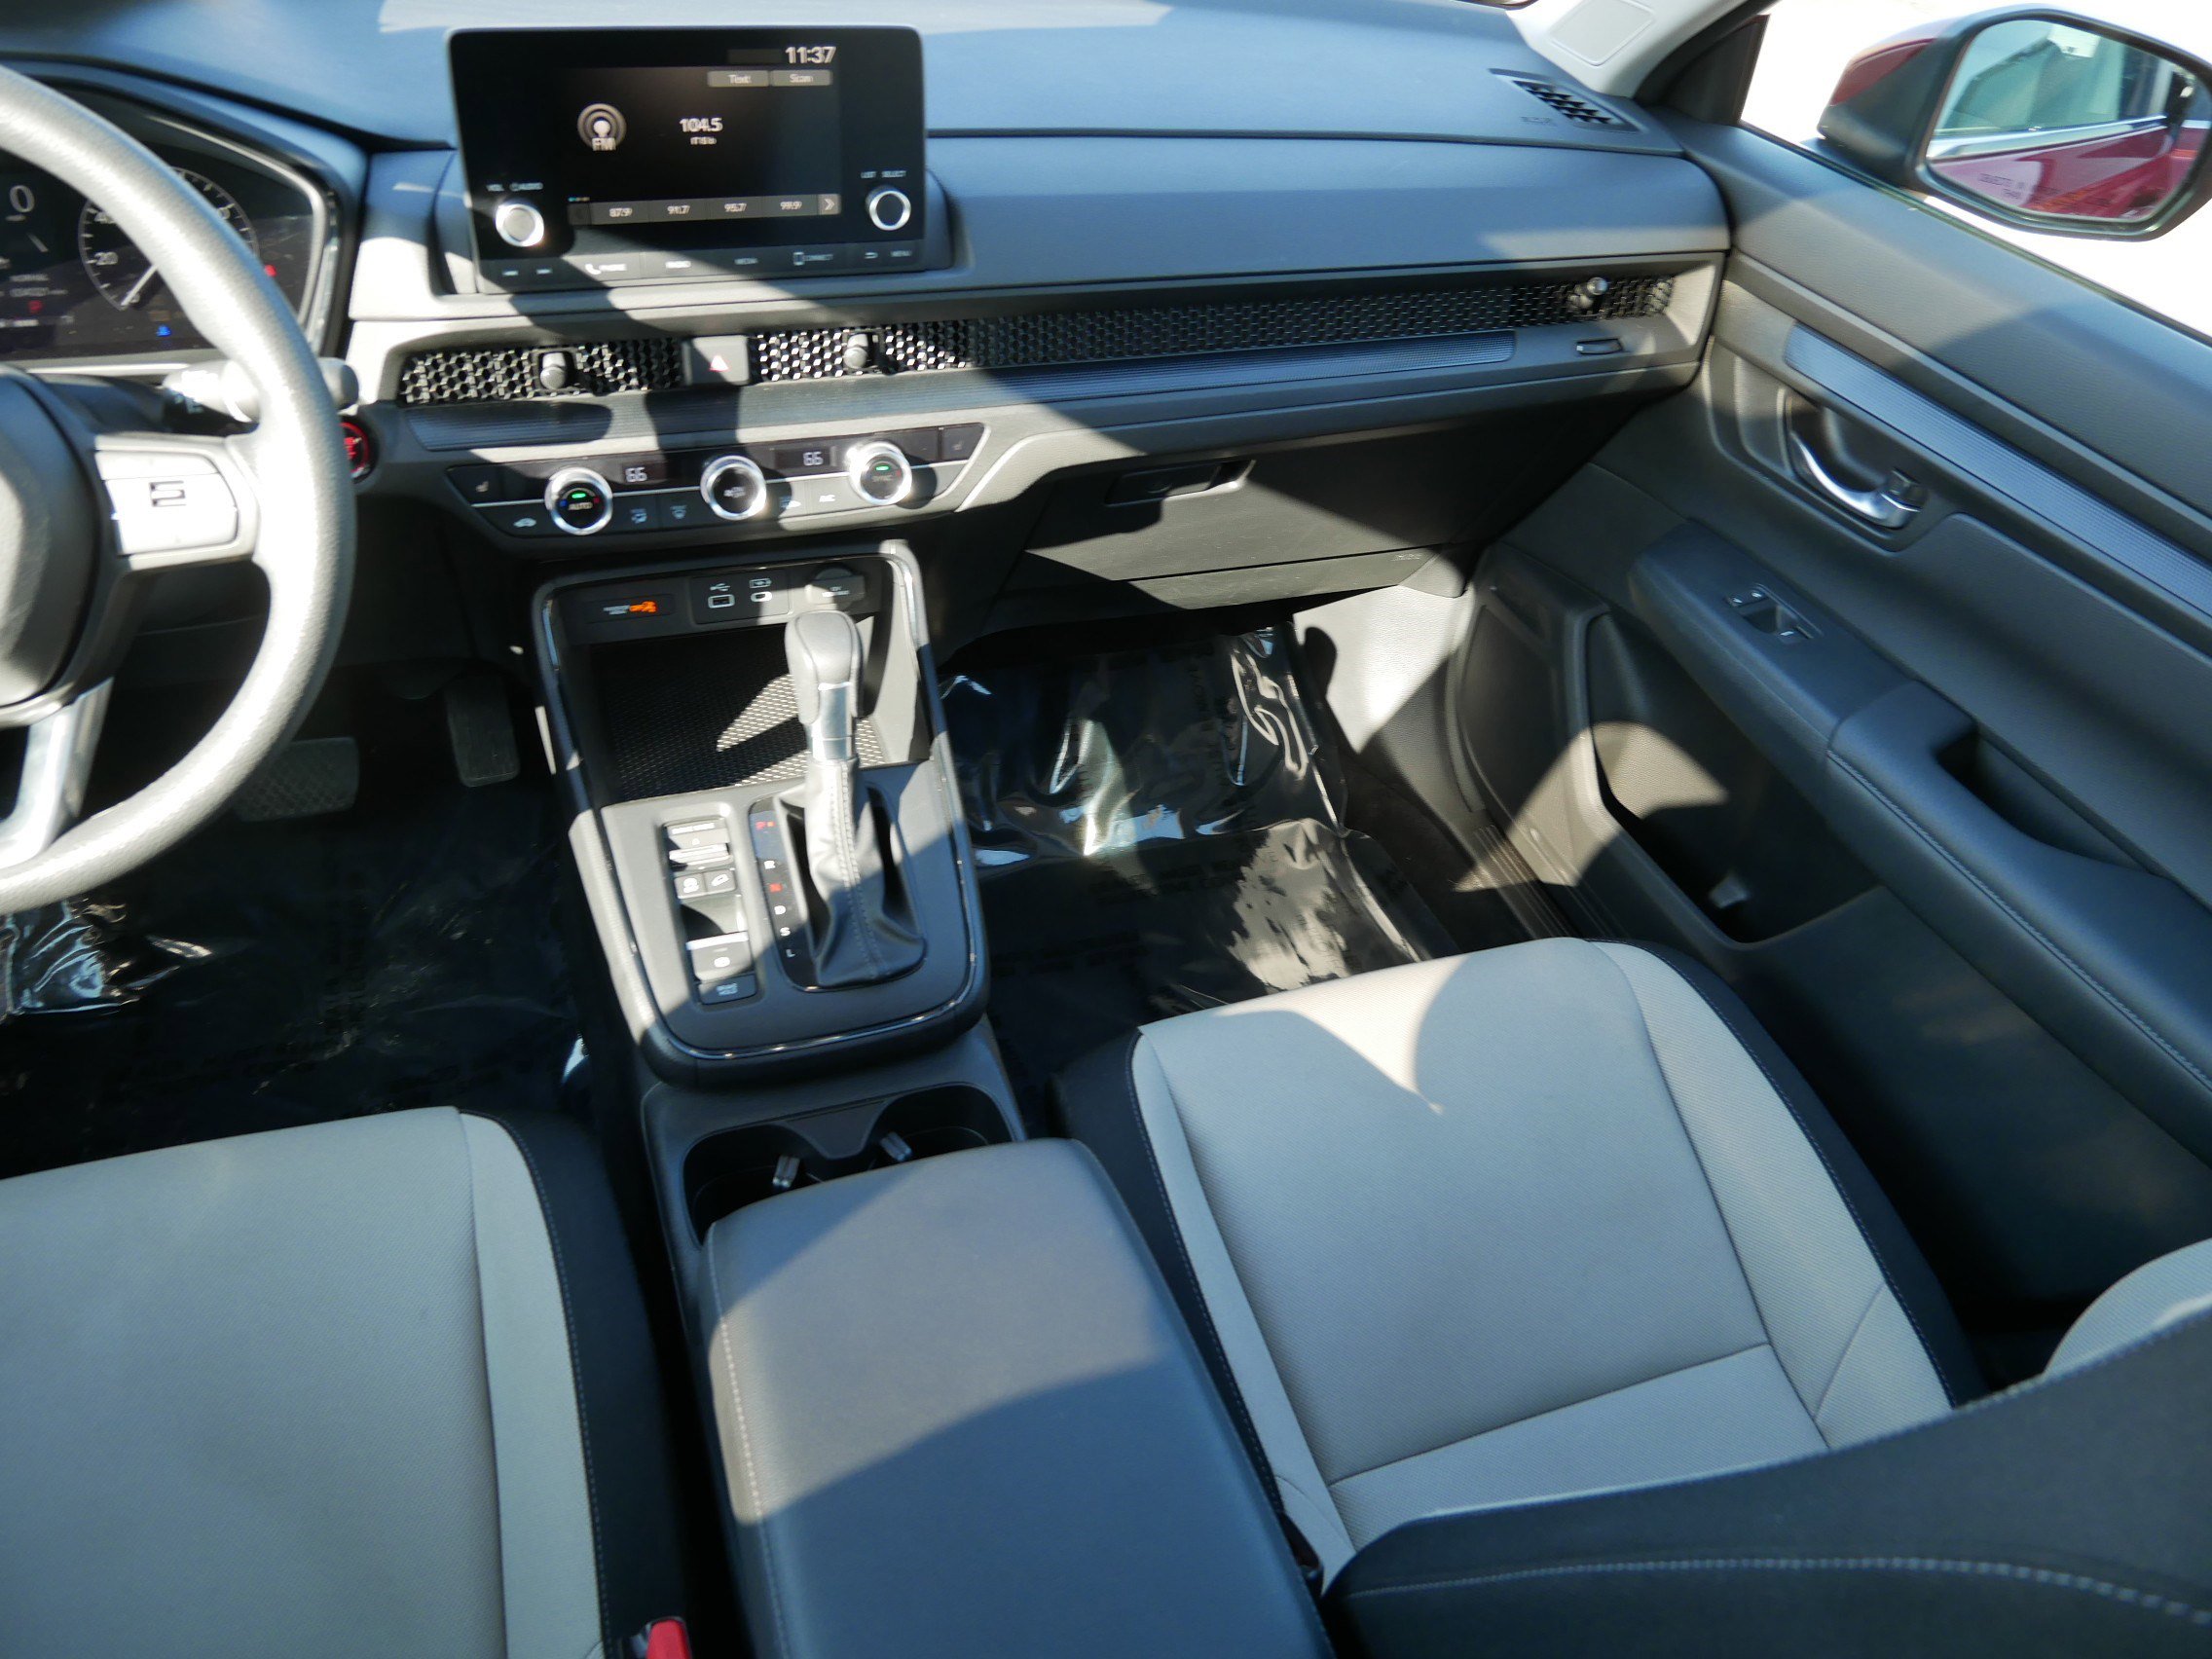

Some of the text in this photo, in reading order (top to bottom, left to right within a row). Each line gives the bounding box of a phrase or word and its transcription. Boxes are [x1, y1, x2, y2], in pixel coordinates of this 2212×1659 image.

[785, 46, 836, 64] 11:37
[680, 117, 723, 132] 104.5
[9, 184, 35, 213] 0
[780, 927, 791, 936] S
